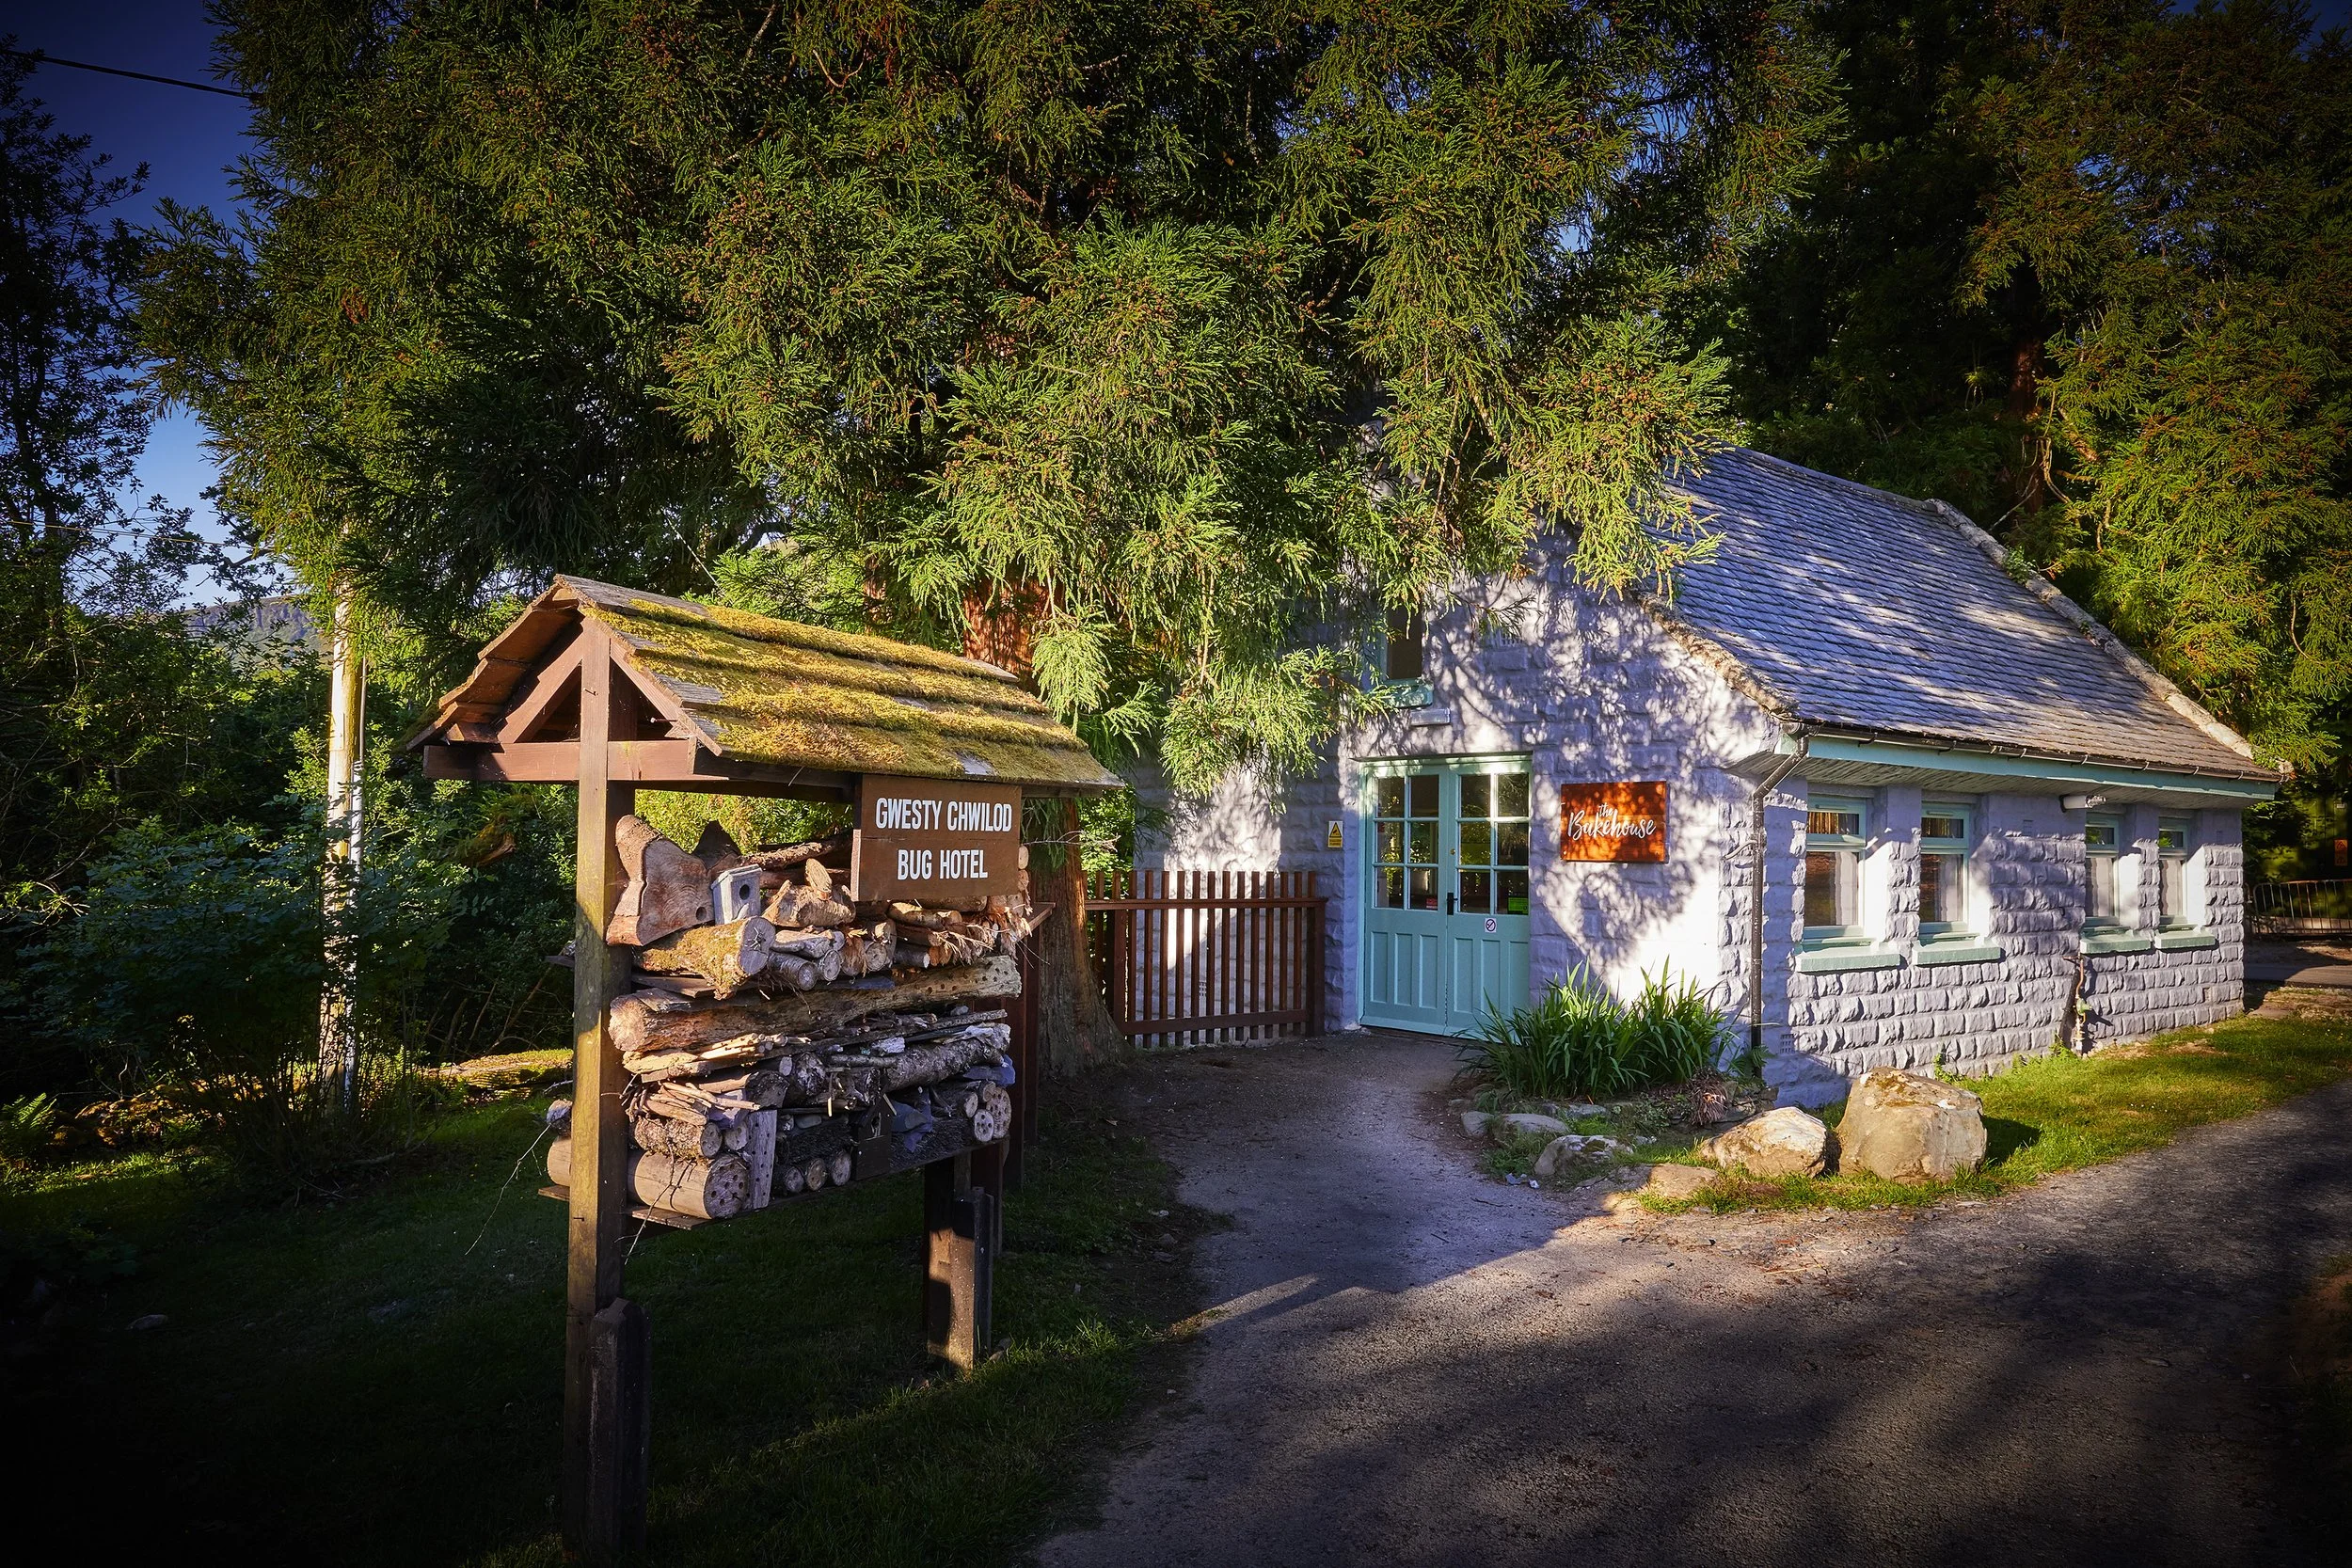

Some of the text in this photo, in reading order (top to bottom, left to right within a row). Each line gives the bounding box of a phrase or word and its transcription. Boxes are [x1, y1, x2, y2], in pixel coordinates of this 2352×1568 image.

[875, 797, 1012, 832] GWESTY CHWILOD
[1567, 809, 1657, 841] Bakehouse
[1597, 801, 1614, 817] the
[897, 848, 989, 880] BUG HOTEL
